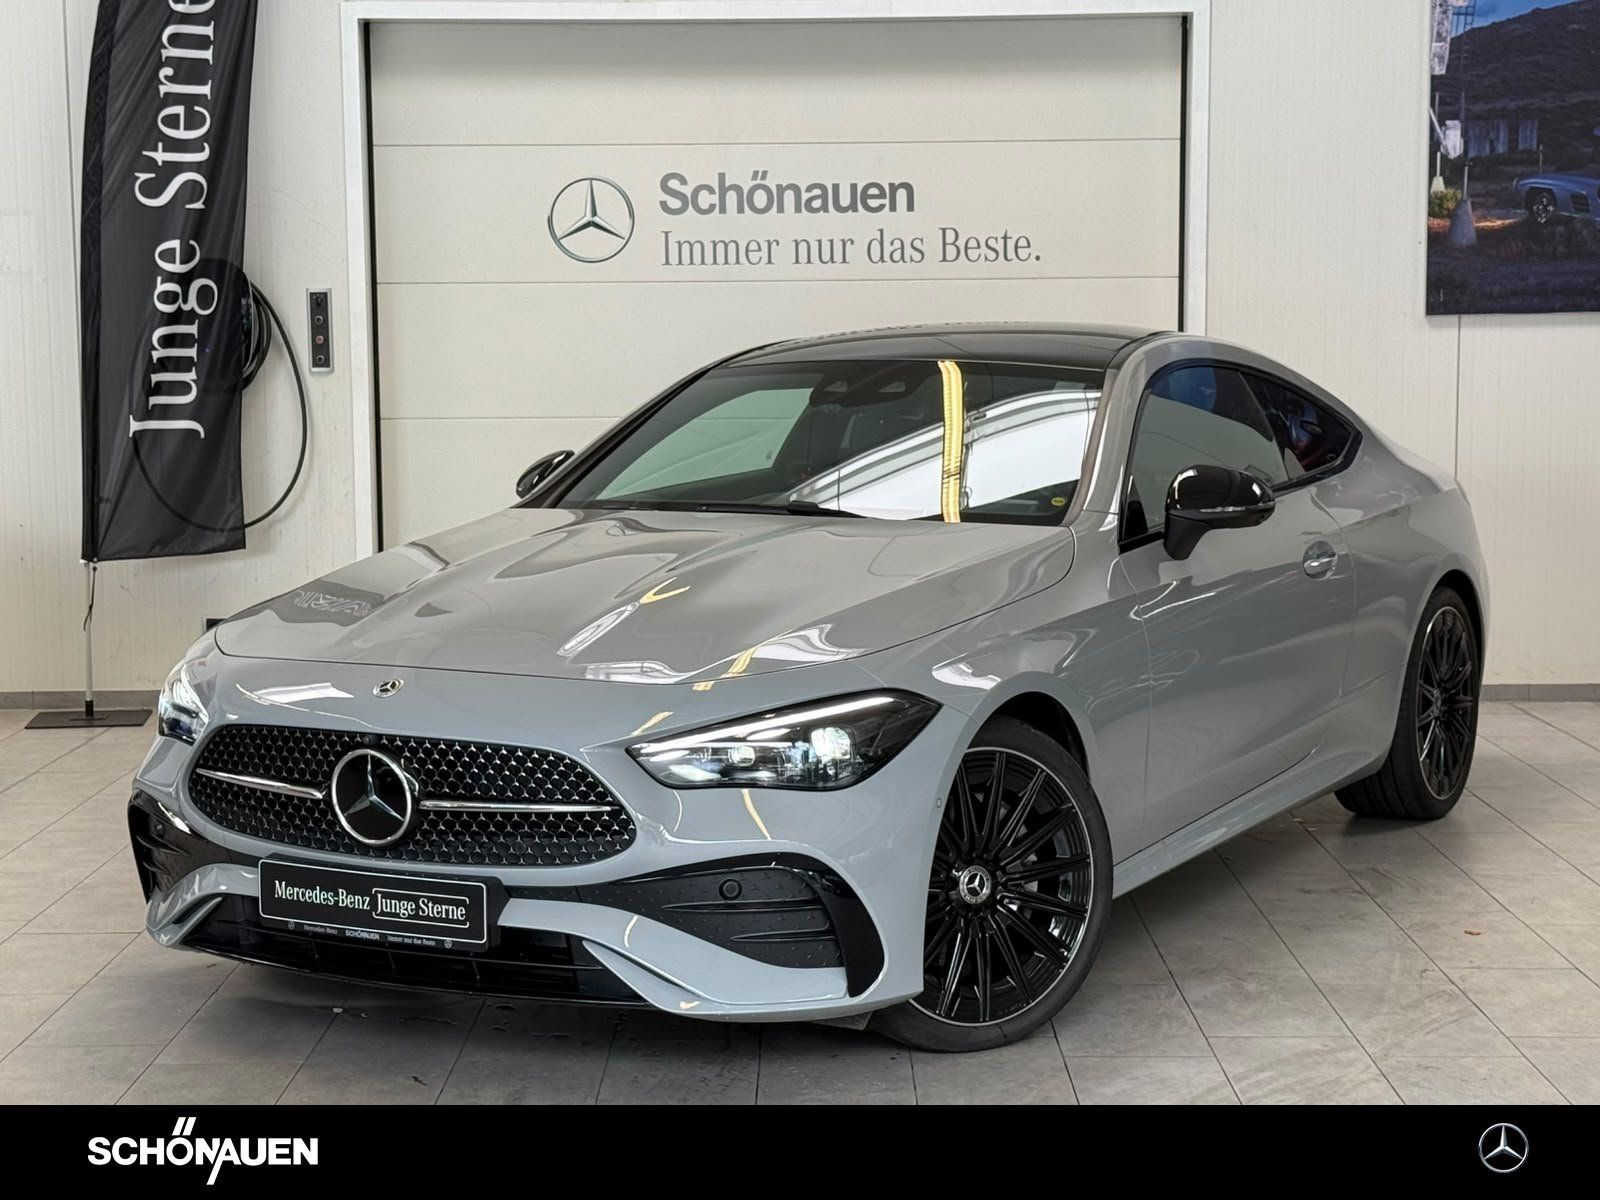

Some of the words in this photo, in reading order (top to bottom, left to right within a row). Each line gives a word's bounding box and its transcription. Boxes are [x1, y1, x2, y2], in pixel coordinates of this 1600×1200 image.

[658, 169, 916, 216] Schönauen
[660, 230, 780, 267] Immer
[791, 235, 855, 266] nur
[866, 228, 926, 265] das
[938, 226, 1042, 264] Beste.
[129, 239, 218, 439] Junge
[274, 880, 371, 911] Mercedes-Benz
[376, 893, 416, 917] Junge
[418, 897, 466, 921] Sterne
